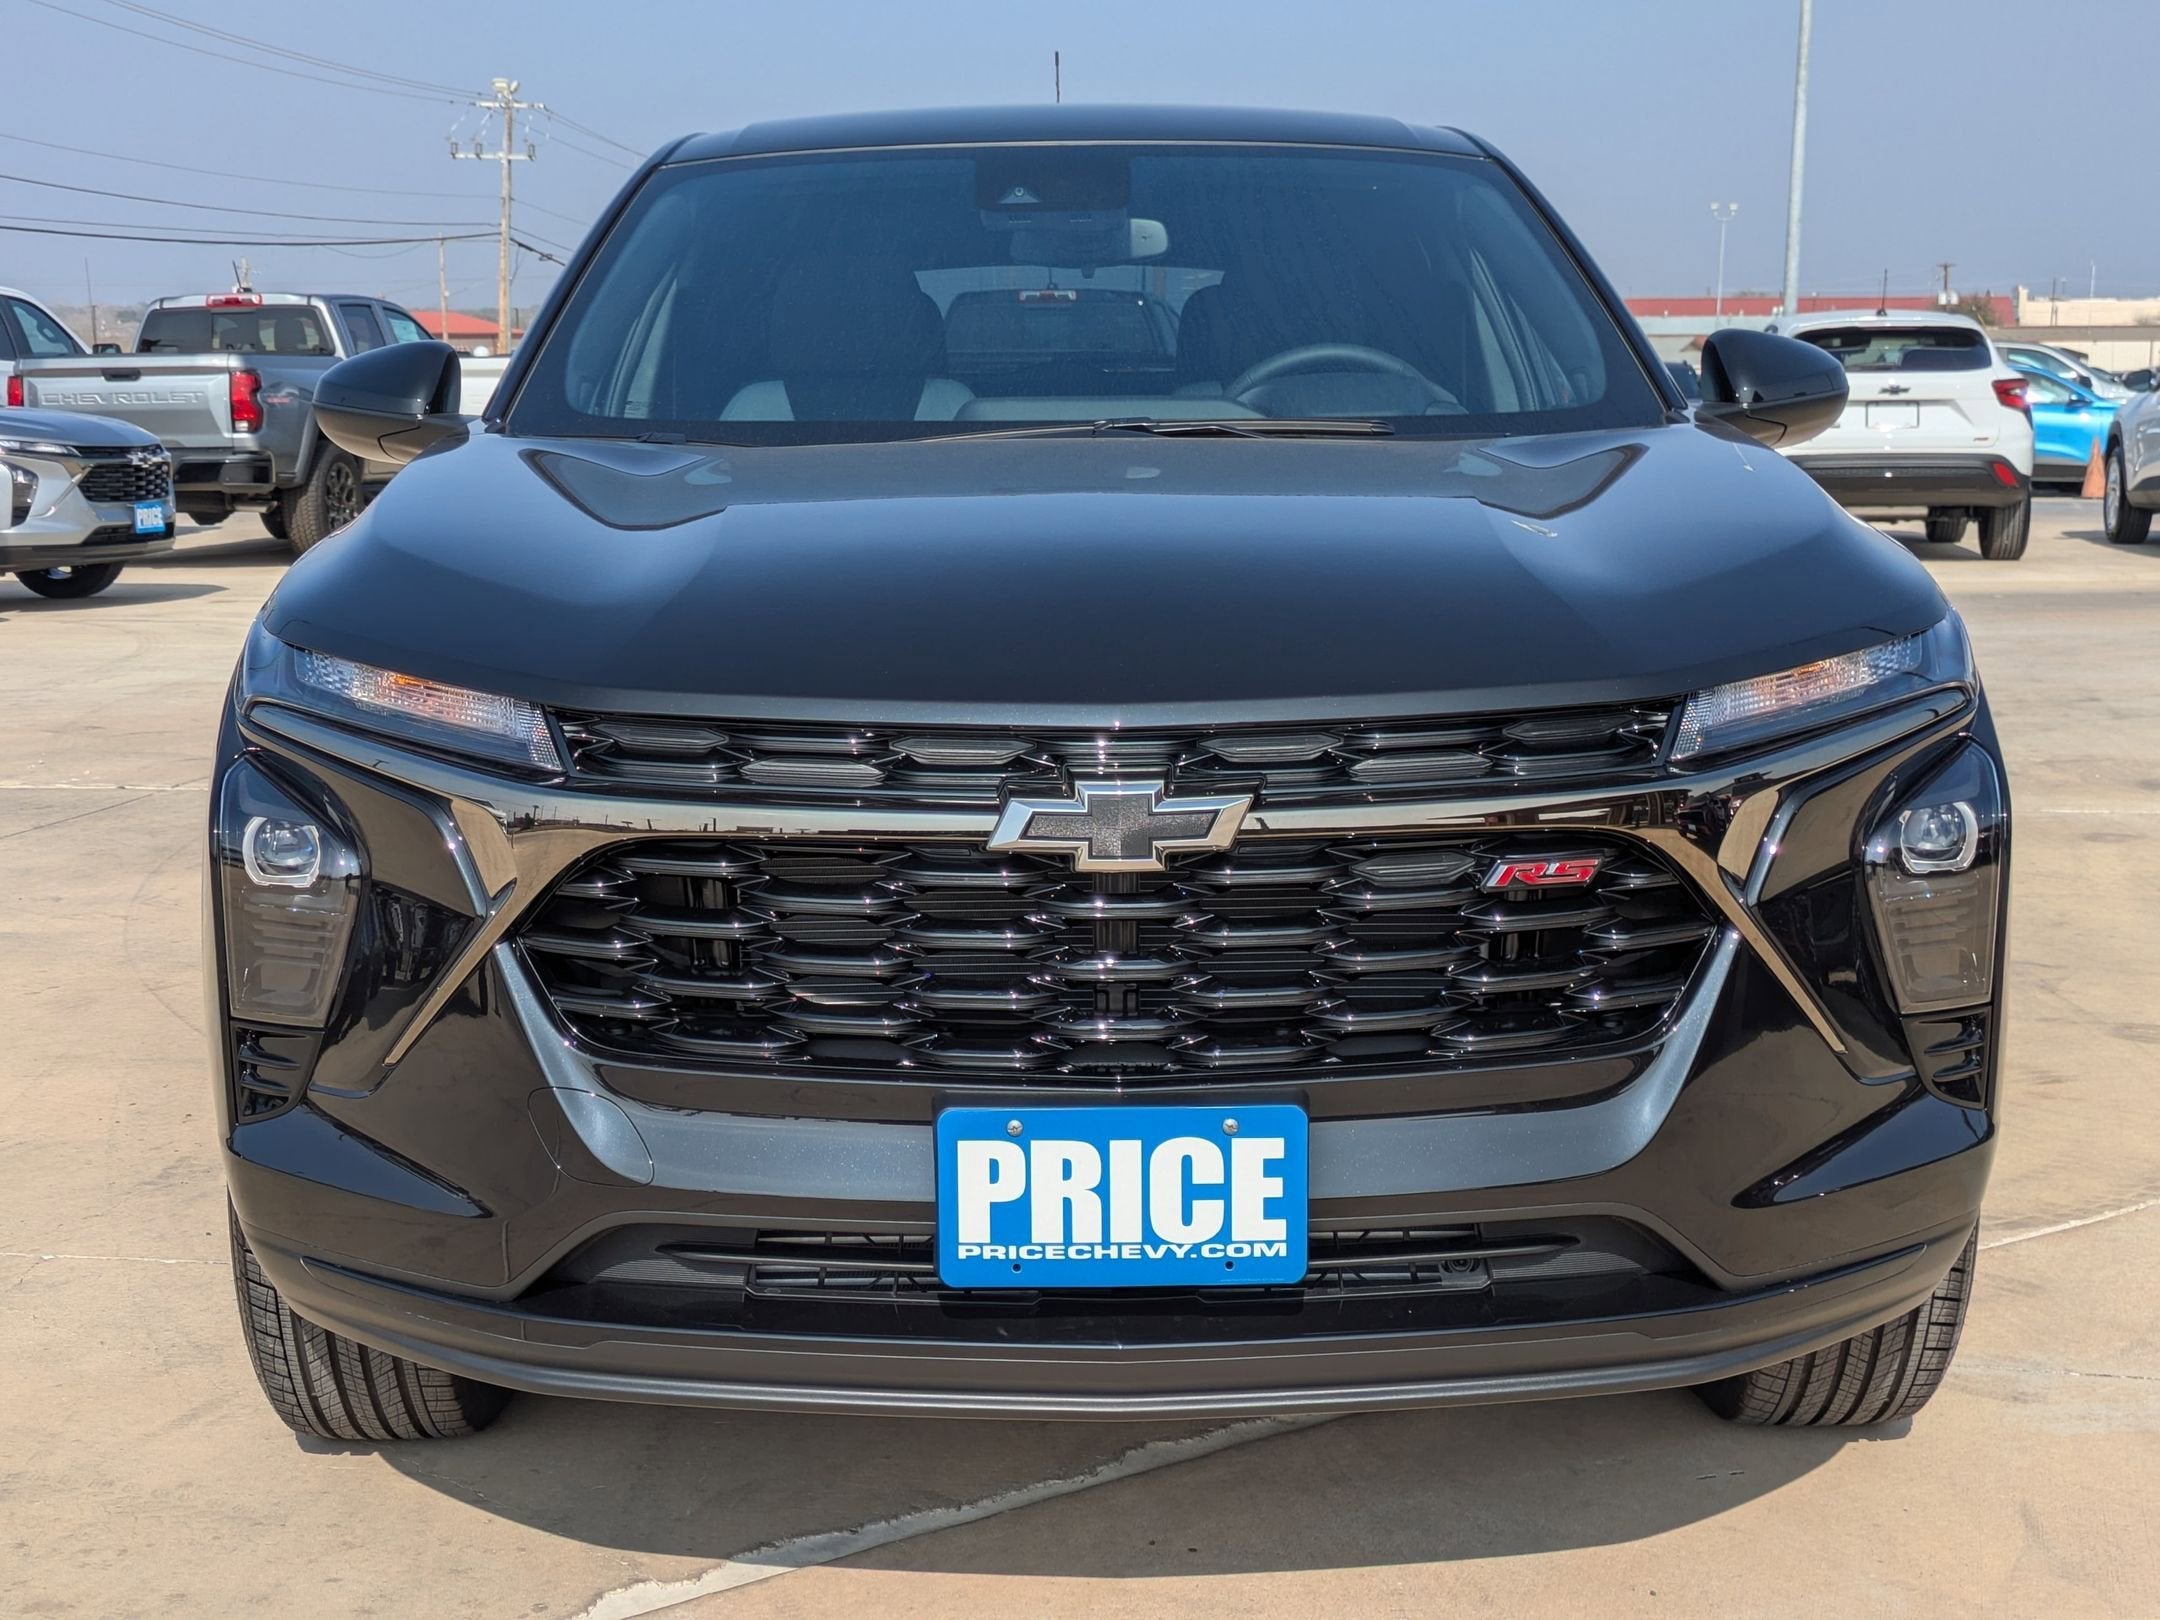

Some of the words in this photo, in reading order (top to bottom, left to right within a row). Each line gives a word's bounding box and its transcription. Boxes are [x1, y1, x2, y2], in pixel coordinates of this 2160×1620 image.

[41, 391, 205, 406] CHEVROLET
[1486, 859, 1599, 887] RS
[957, 1137, 1287, 1244] PRICE
[958, 1243, 1287, 1260] PRICECHEVY.COM
